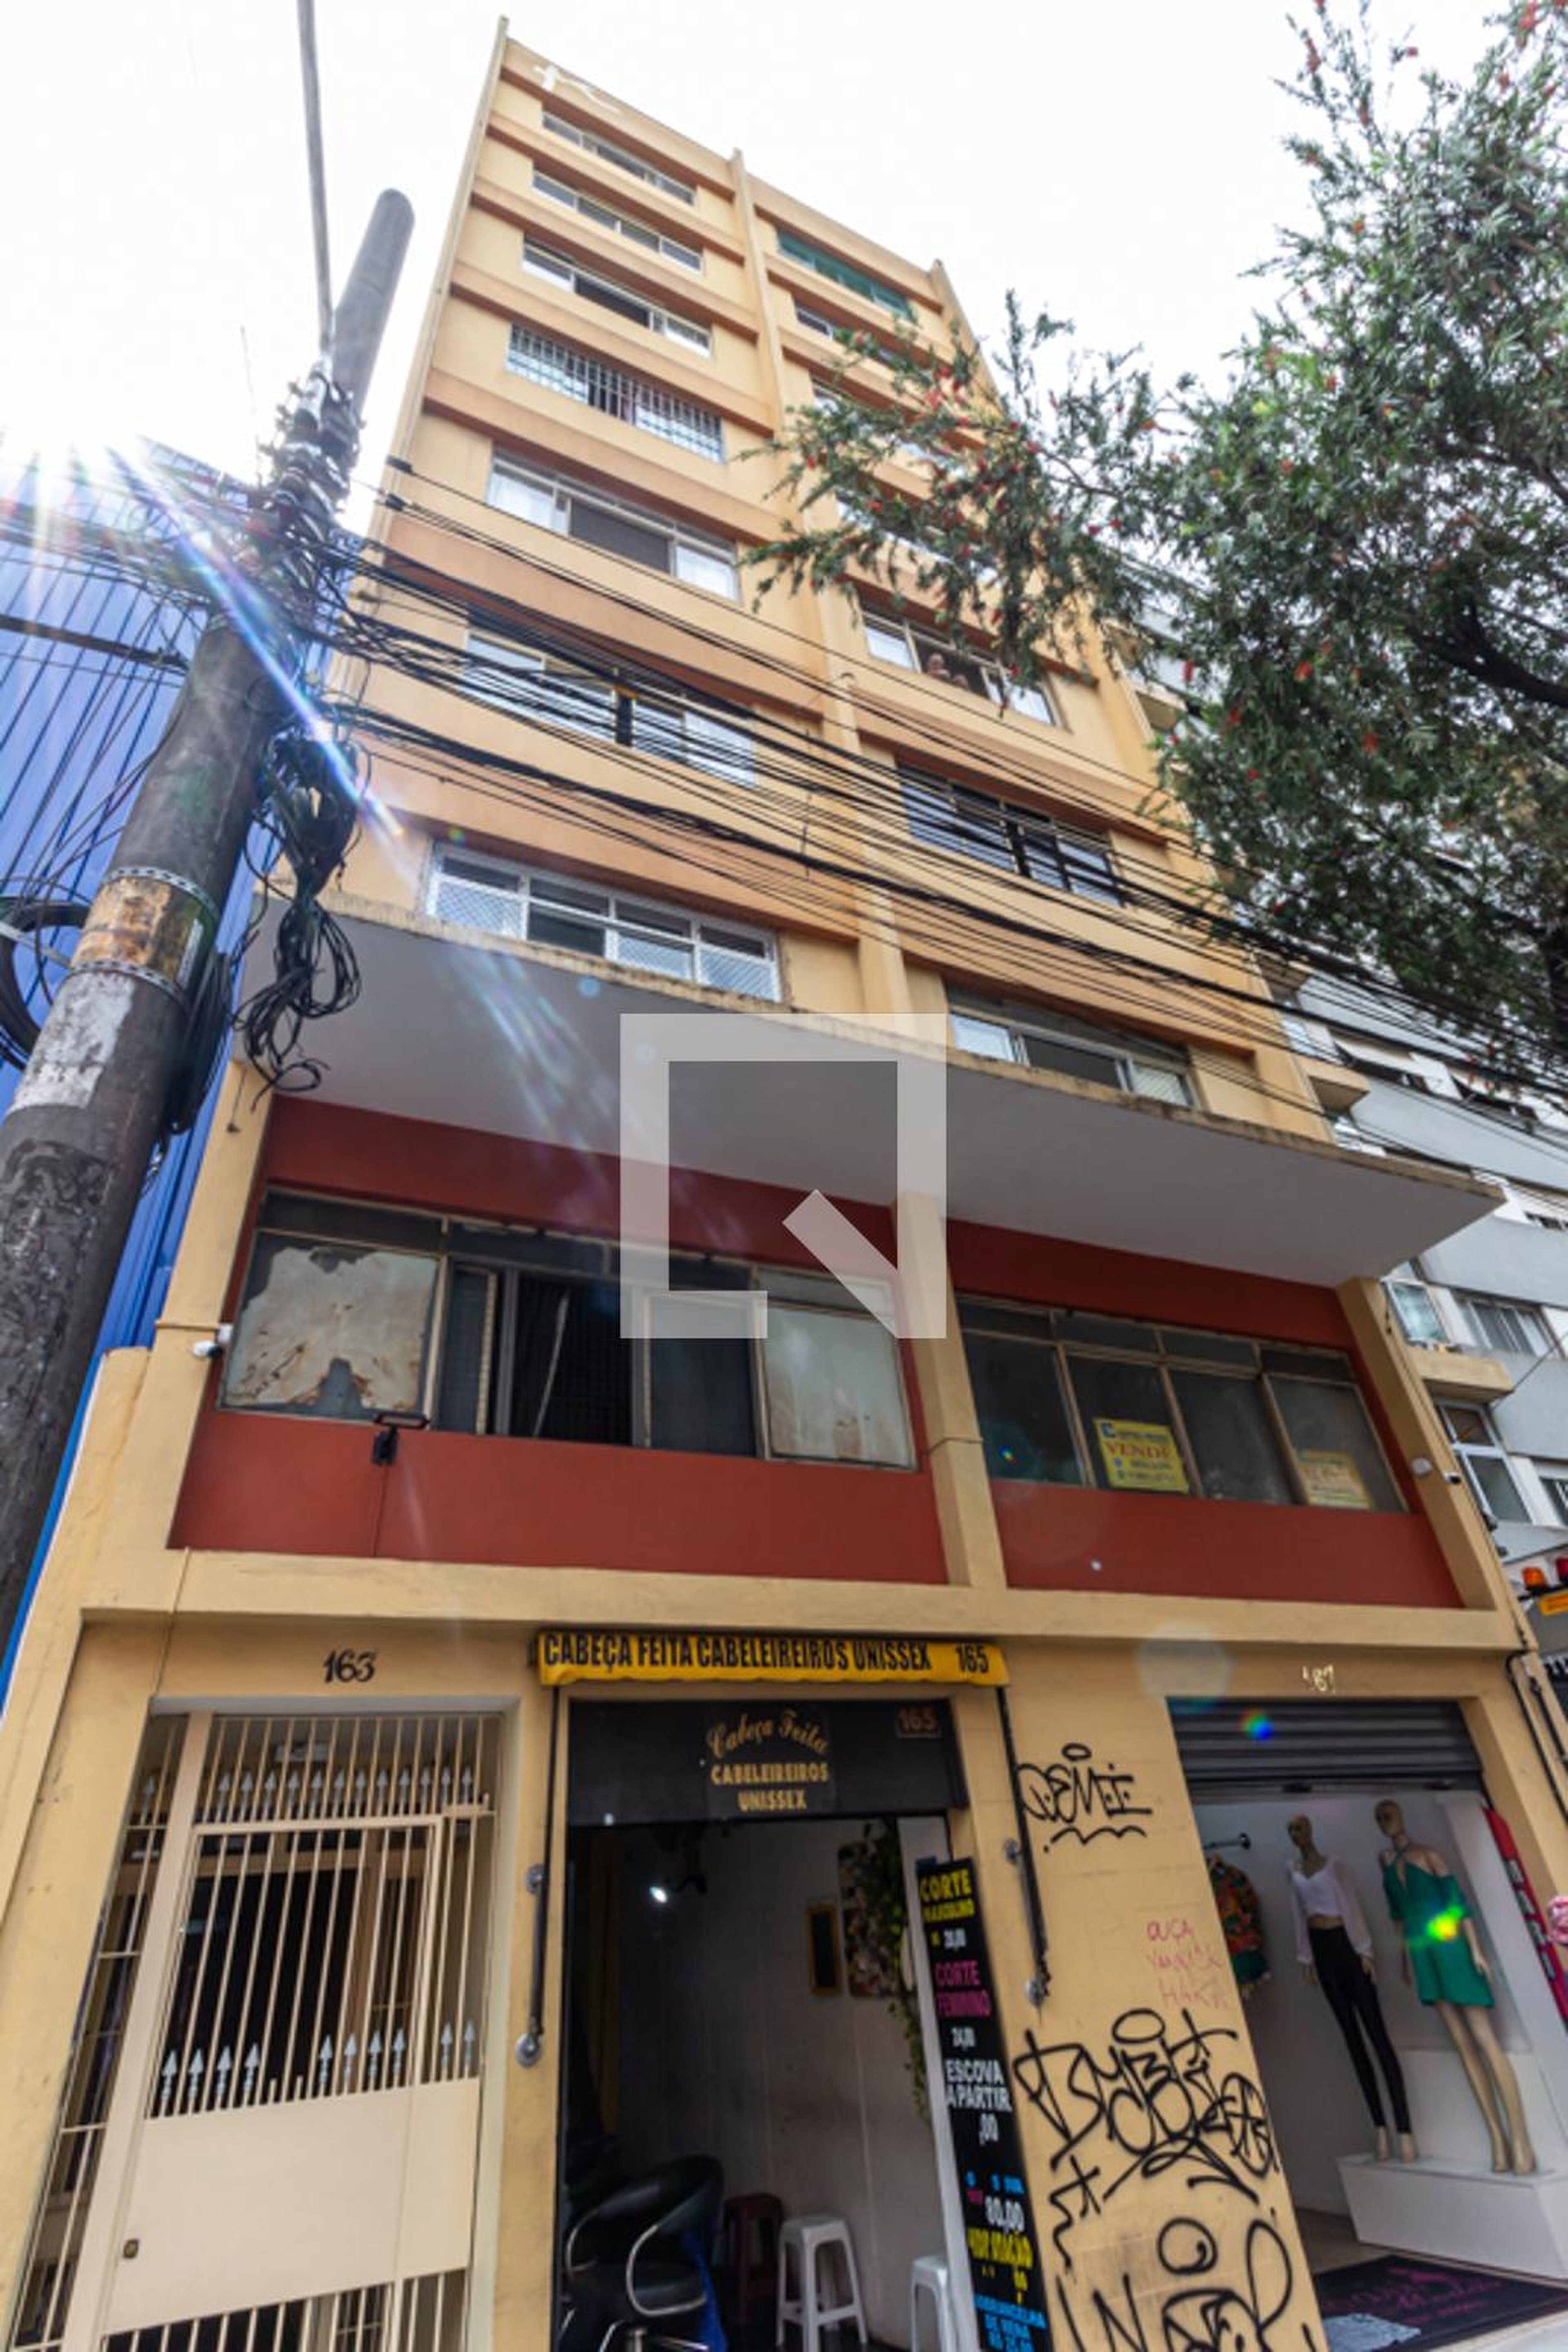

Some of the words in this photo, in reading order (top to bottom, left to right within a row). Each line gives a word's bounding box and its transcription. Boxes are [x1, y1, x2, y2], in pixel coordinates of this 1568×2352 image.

[323, 1648, 378, 1684] 163
[544, 1633, 632, 1673] CABEÇA
[638, 1635, 694, 1666] FEITA
[696, 1635, 849, 1670] CABELEIREIROS
[853, 1639, 932, 1671] UNISSEX
[955, 1643, 989, 1673] 165
[919, 1868, 973, 1902] CORTE
[946, 2058, 1004, 2085] ESCOVA
